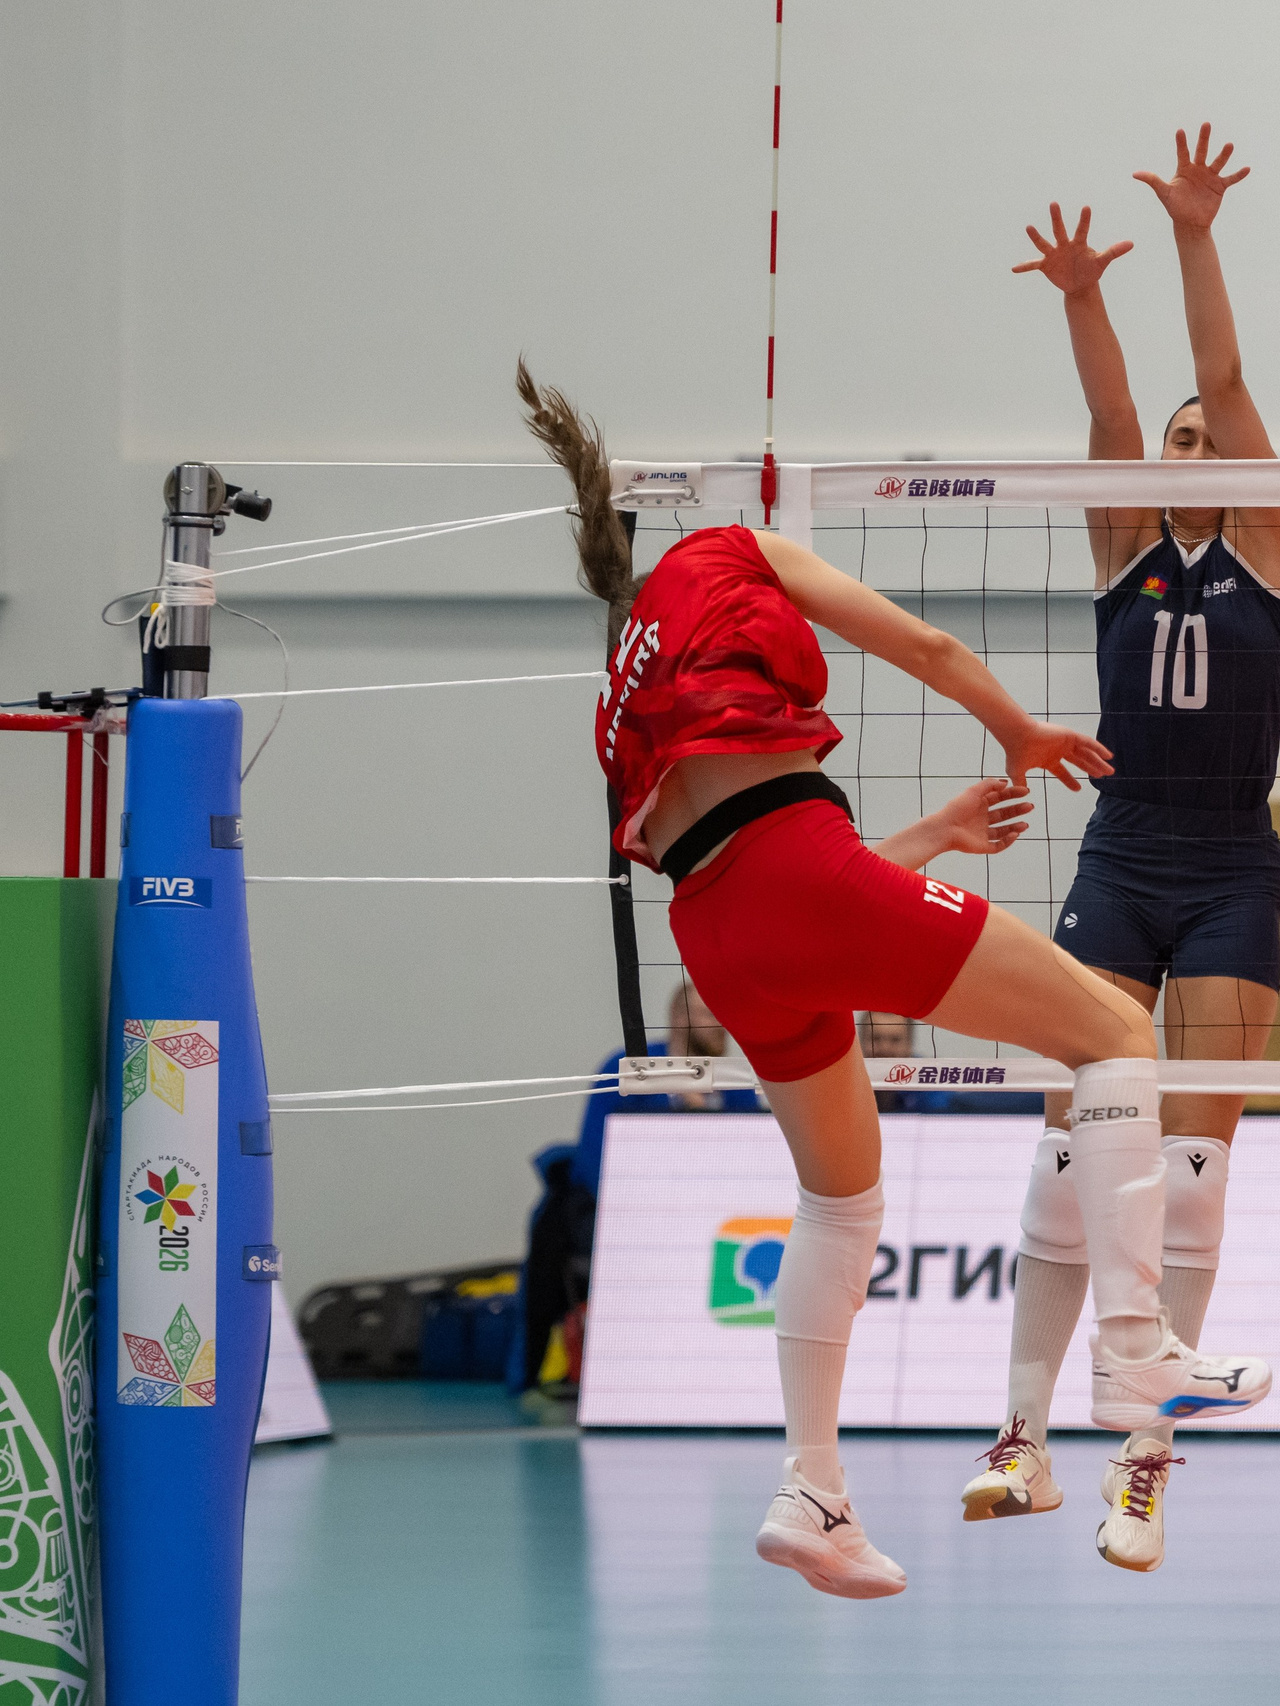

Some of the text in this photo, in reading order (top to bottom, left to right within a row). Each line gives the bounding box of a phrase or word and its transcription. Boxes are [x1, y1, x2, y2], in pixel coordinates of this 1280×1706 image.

[908, 479, 996, 497] 金陵体育
[1149, 609, 1209, 710] 10
[142, 877, 195, 897] FIVB
[923, 880, 965, 914] 12
[918, 1066, 1006, 1085] 金陵体育
[1079, 1106, 1139, 1122] ZEDO
[125, 1155, 209, 1222] СПАРТАКИАДА НАРОДОВ РОССИИ
[158, 1225, 190, 1272] 2026
[866, 1244, 1018, 1300] 2ГИ
